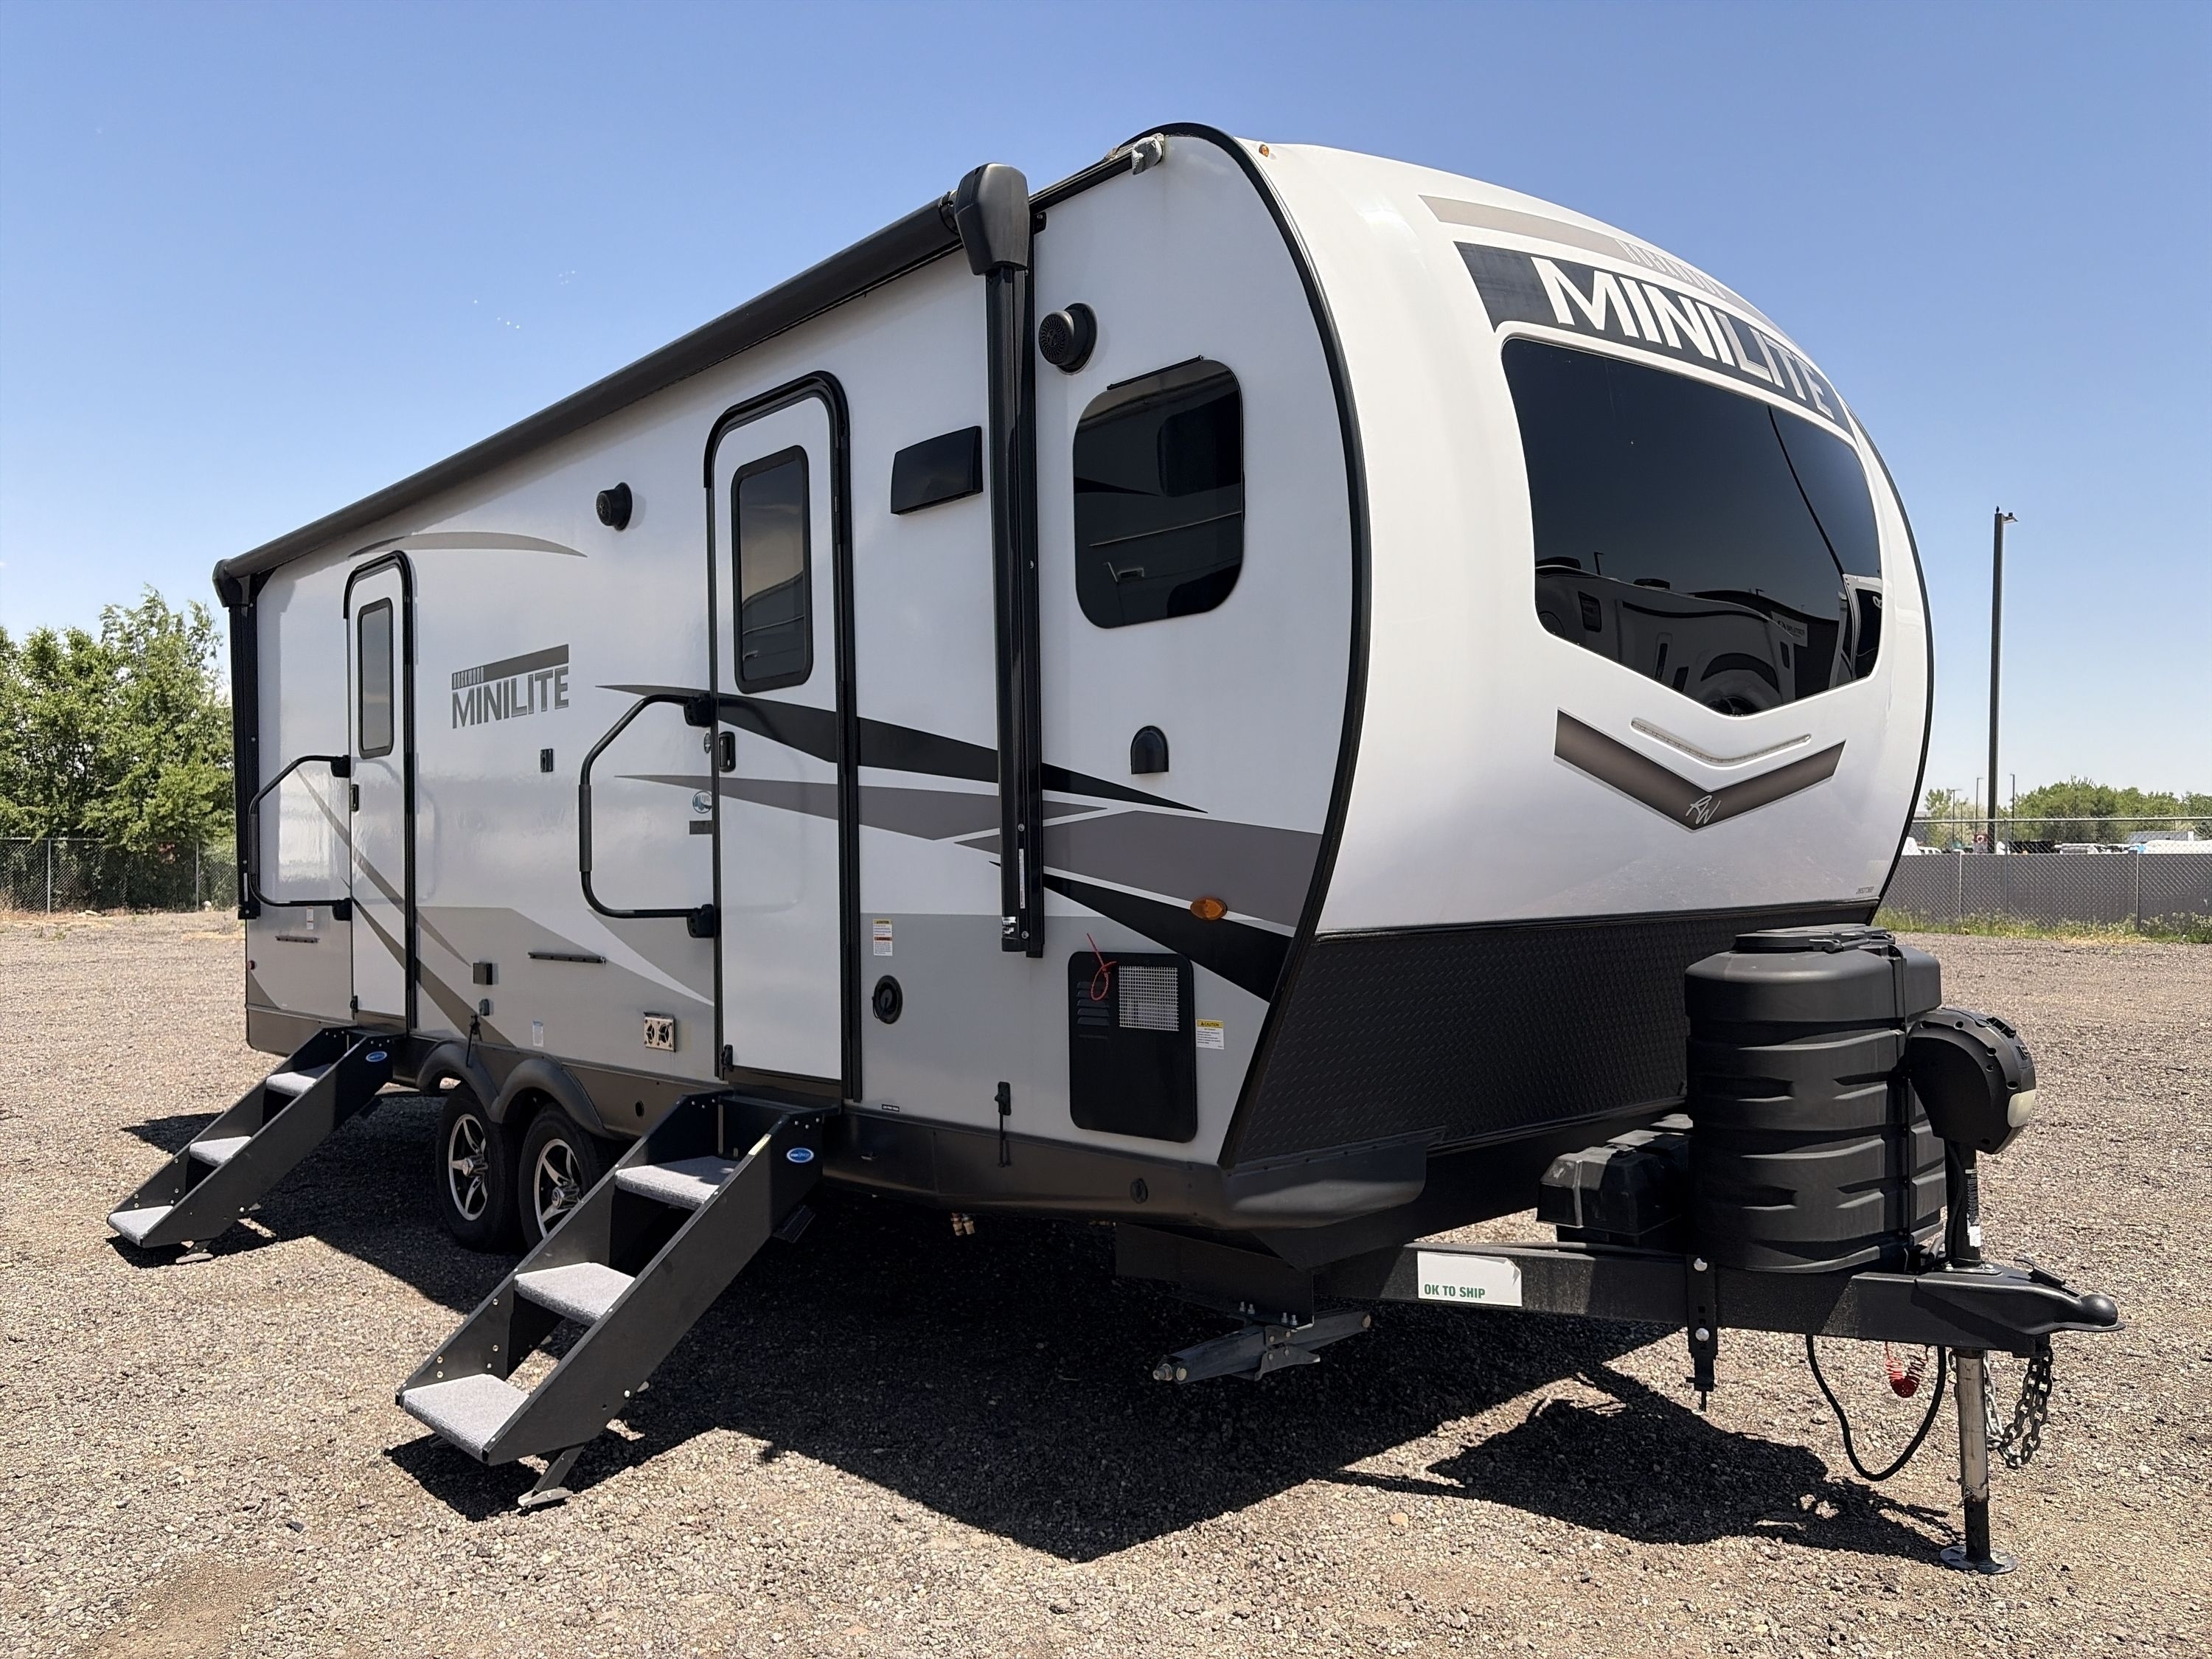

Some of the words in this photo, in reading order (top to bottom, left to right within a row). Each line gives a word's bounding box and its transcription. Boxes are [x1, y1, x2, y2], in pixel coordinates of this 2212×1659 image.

[1530, 257, 1835, 420] MINILITE
[452, 666, 569, 729] MINILITE
[1424, 1284, 1439, 1295] OK
[1442, 1285, 1456, 1297] TO
[1459, 1287, 1486, 1299] SHIP
